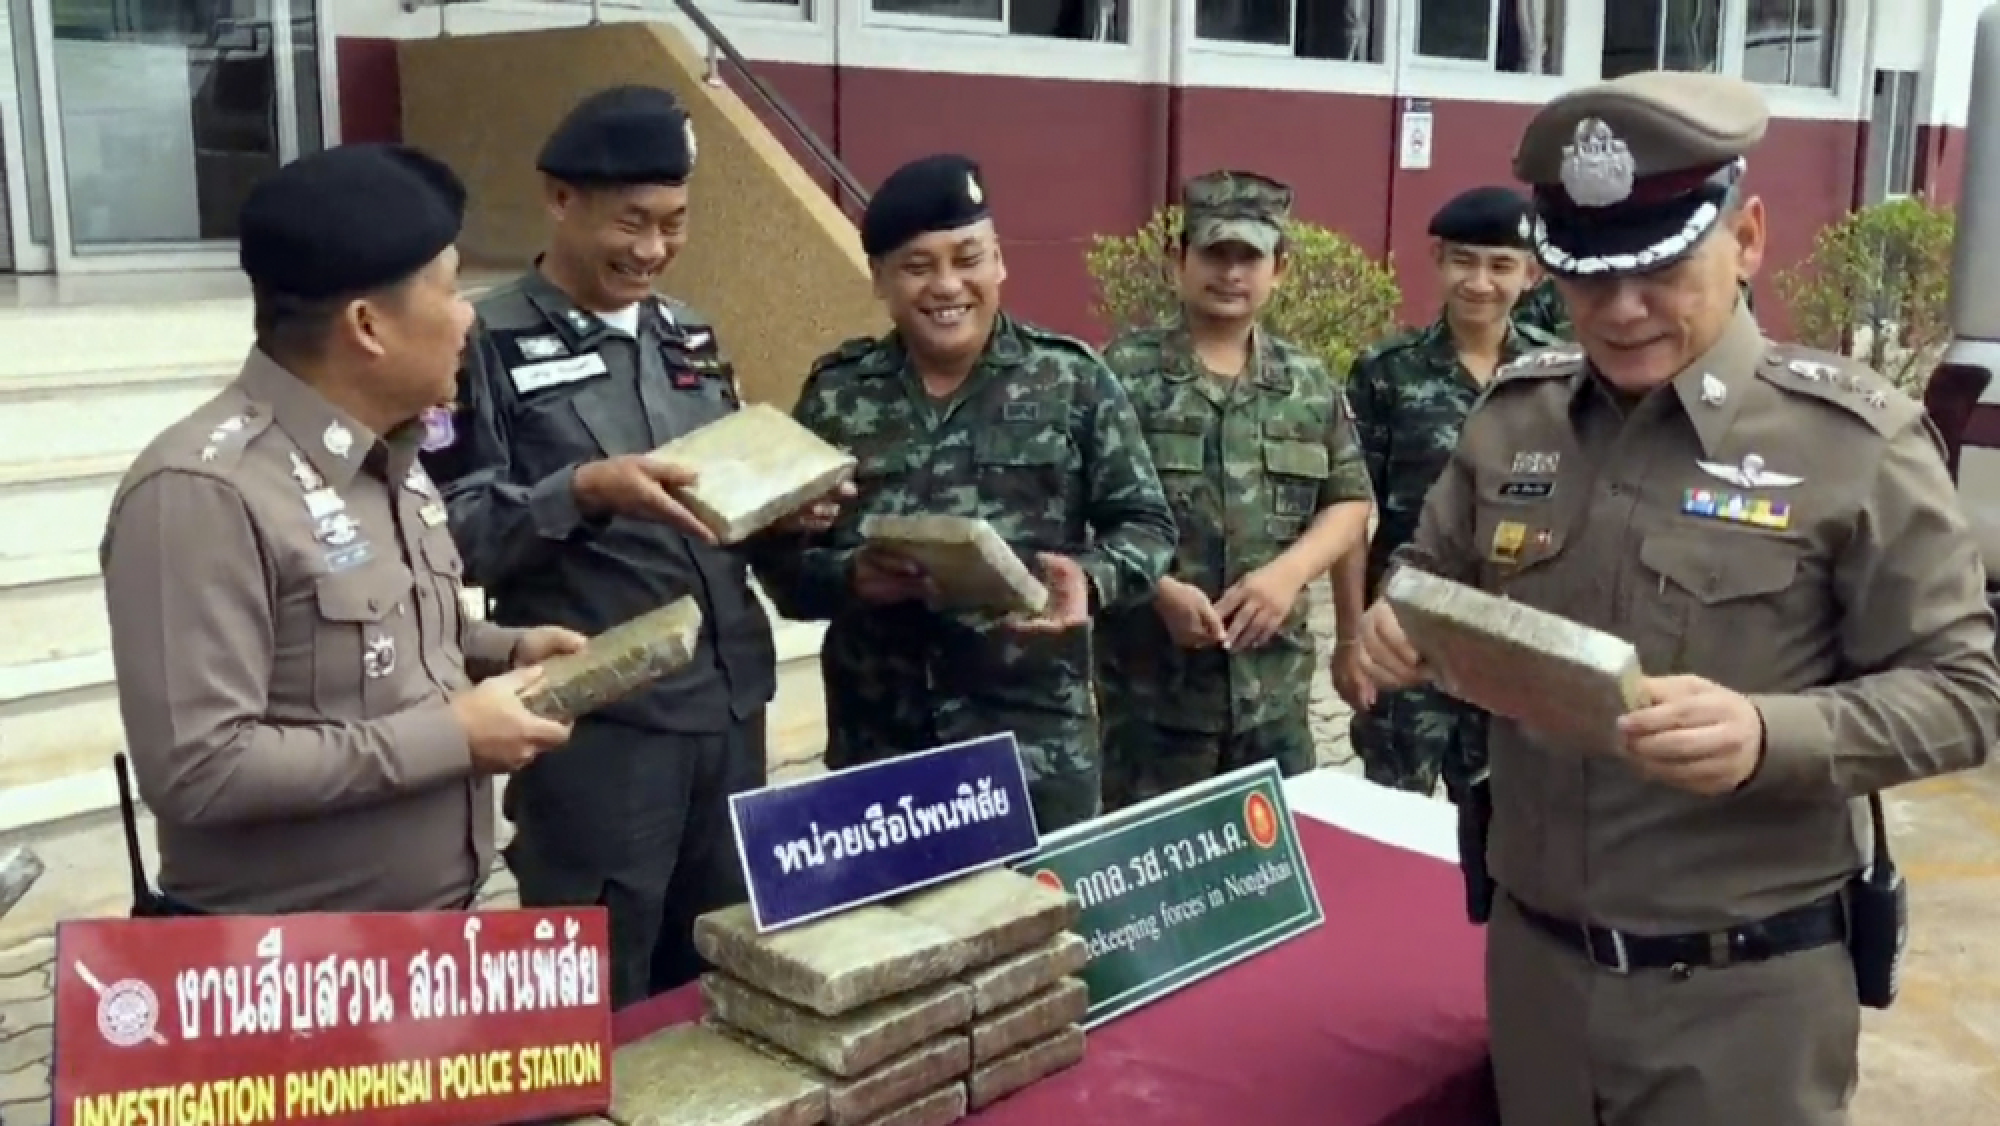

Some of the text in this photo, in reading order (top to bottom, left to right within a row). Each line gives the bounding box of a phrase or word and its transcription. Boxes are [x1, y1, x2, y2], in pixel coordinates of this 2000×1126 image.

[773, 776, 1010, 874] หน่วยเรือโพนพิสัย
[1160, 901, 1206, 927] forces
[1206, 884, 1225, 908] in
[1224, 853, 1293, 901] Nongkhai
[176, 916, 599, 1040] งานสืบสวน สภ.โพนพิสัย
[74, 1042, 602, 1126] INVESTIGATION PHONPHISAI POLICE STATION
